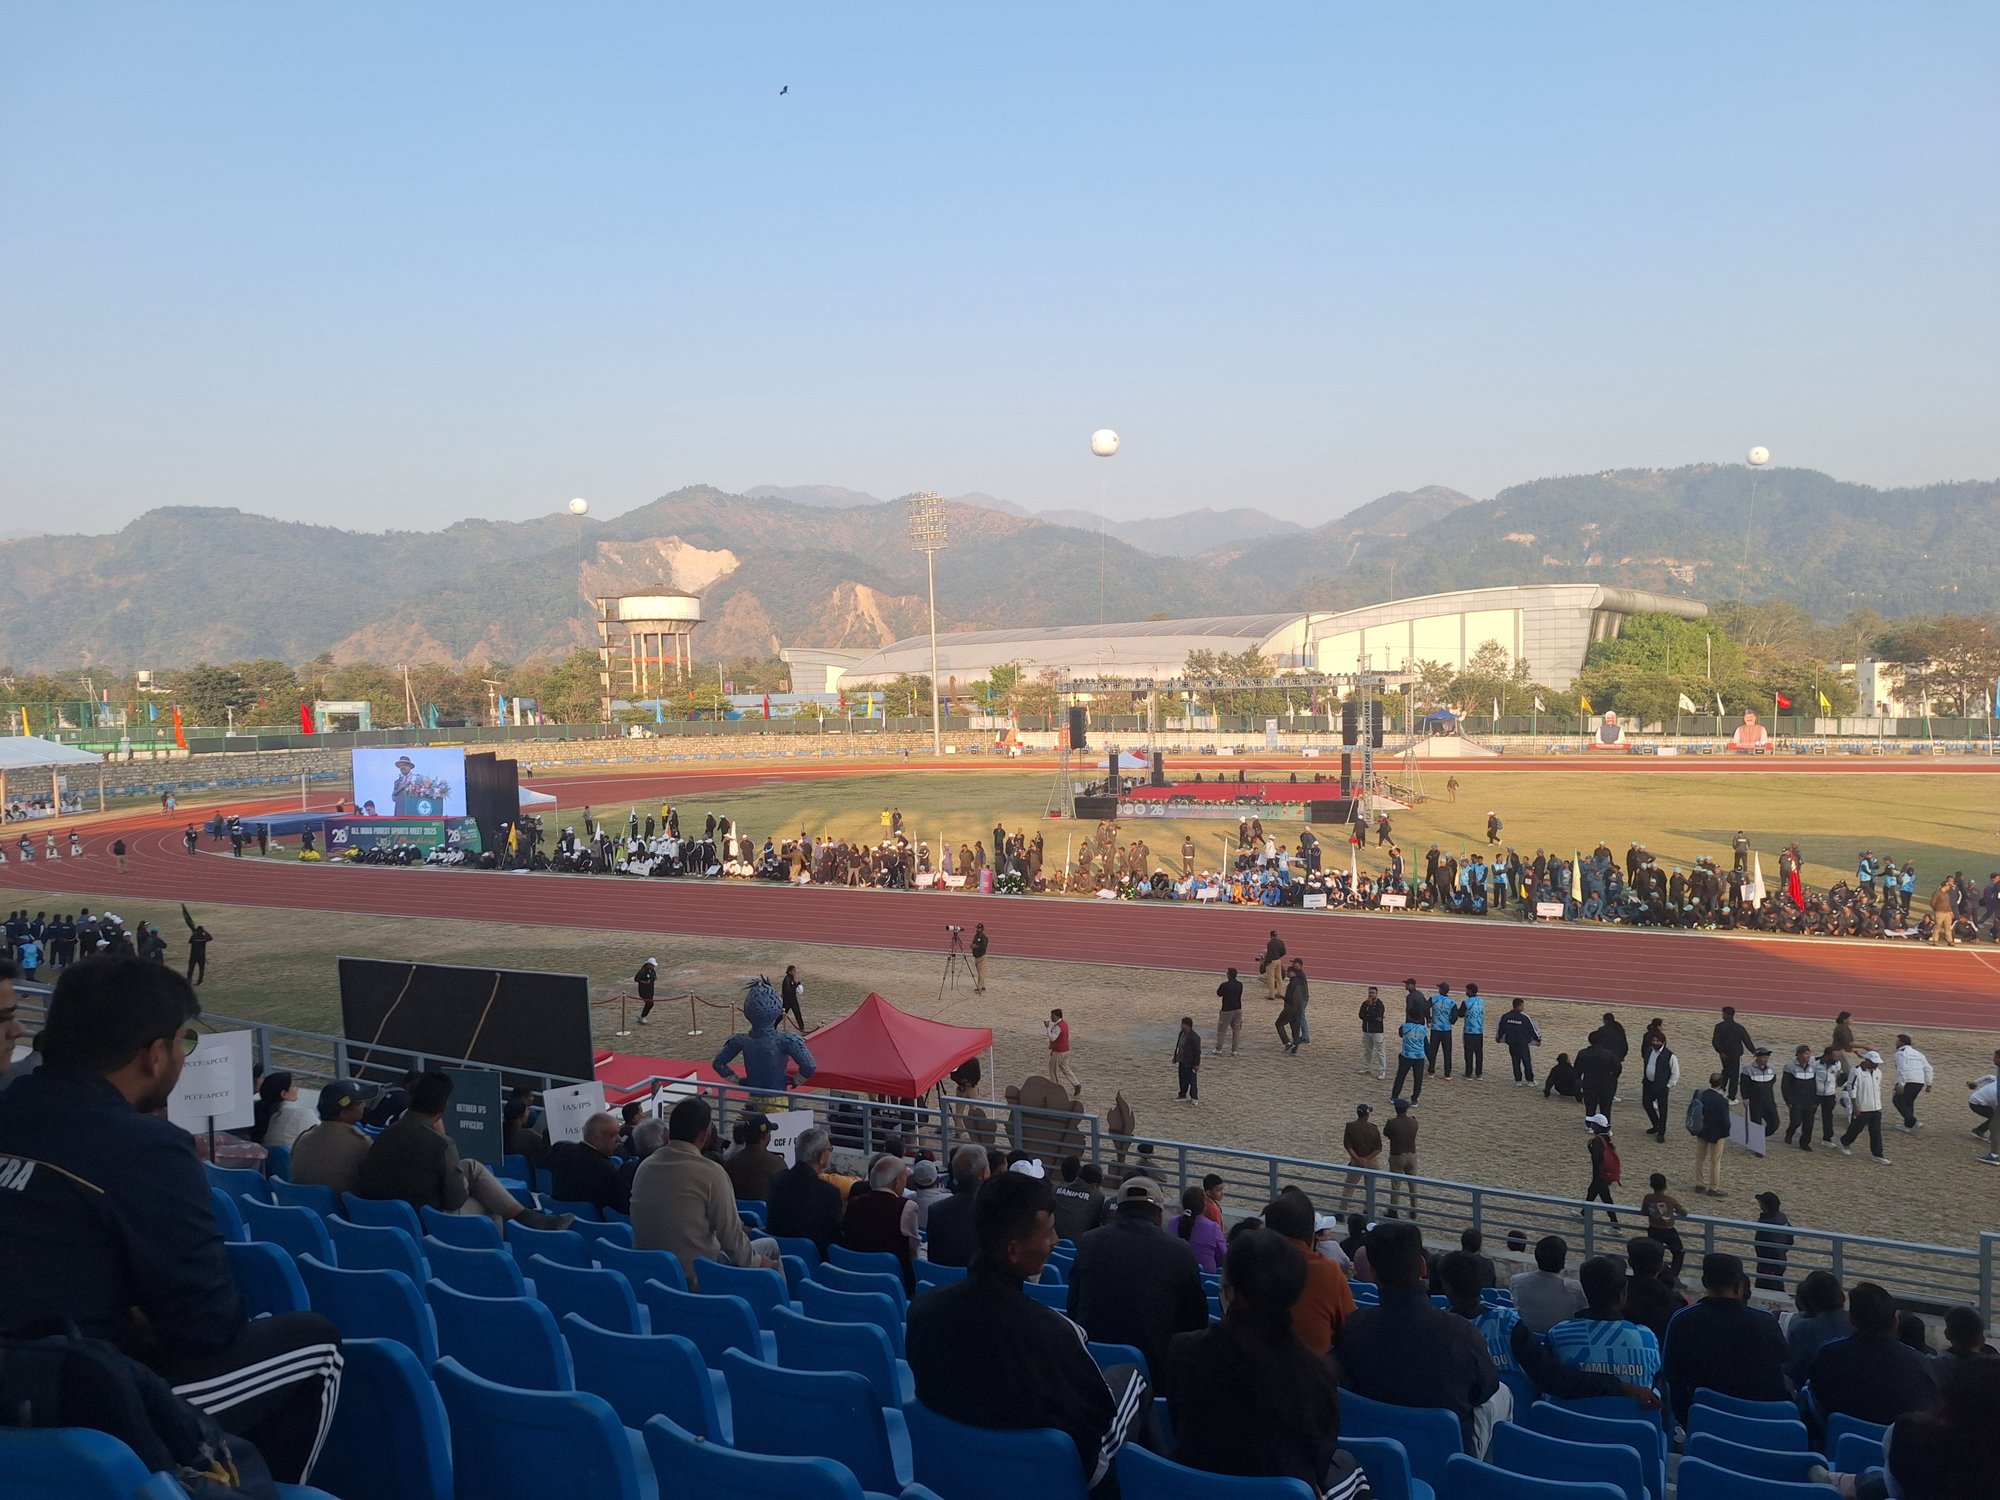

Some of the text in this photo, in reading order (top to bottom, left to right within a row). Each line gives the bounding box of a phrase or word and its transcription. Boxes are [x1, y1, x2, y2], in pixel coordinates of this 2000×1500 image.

[391, 827, 409, 835] SPORTS
[409, 827, 422, 835] MEET
[423, 827, 437, 835] 2025
[184, 1057, 228, 1067] PCCF/APCCF
[185, 1091, 230, 1100] PCCF/APCCF
[456, 1103, 477, 1113] RETIRED
[562, 1101, 592, 1111] IAS/IPS
[460, 1120, 484, 1130] OFFICERS
[774, 1138, 787, 1146] CCF
[1056, 1187, 1090, 1200] MANIPUR
[1579, 1363, 1643, 1376] TAMILNADU
